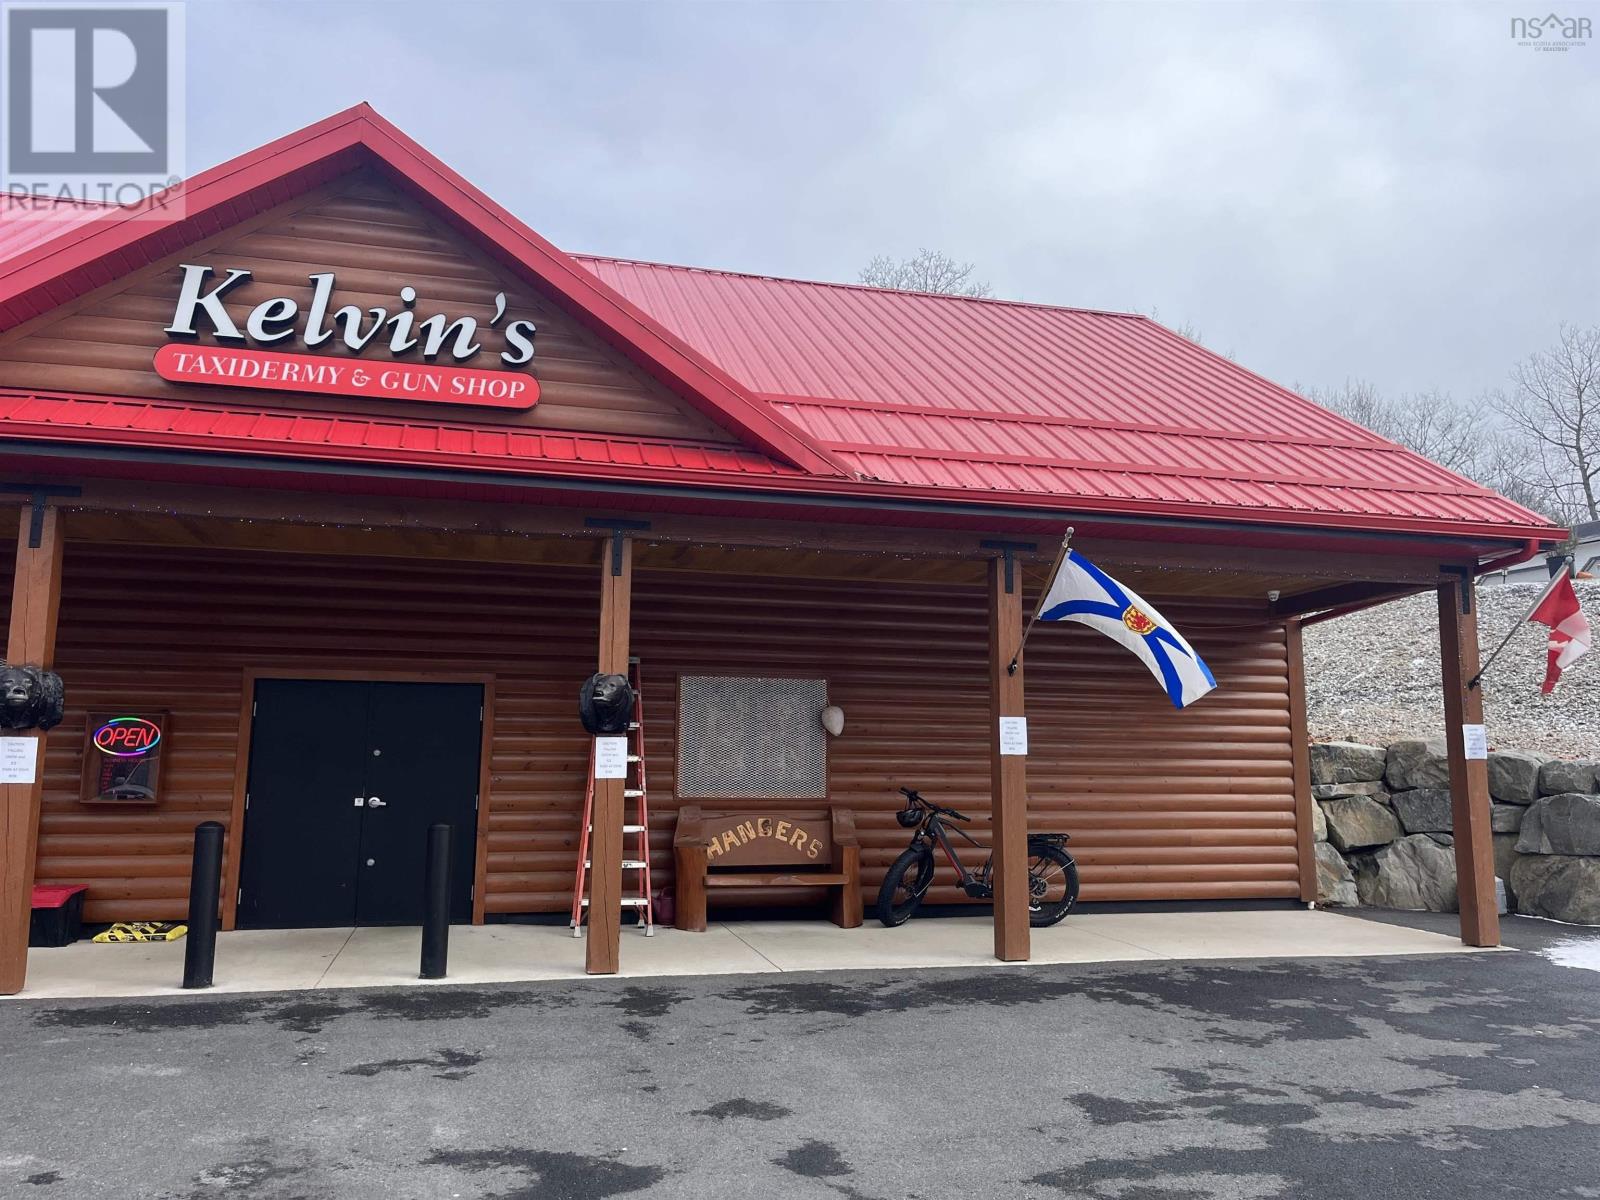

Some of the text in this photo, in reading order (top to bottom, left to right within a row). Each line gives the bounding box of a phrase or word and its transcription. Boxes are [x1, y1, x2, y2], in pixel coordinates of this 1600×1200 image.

[164, 264, 537, 364] Kelvin's
[173, 352, 526, 400] TAXIDERMY & GUN SHOP
[97, 727, 155, 747] OPEN
[706, 818, 823, 860] HANGERS
